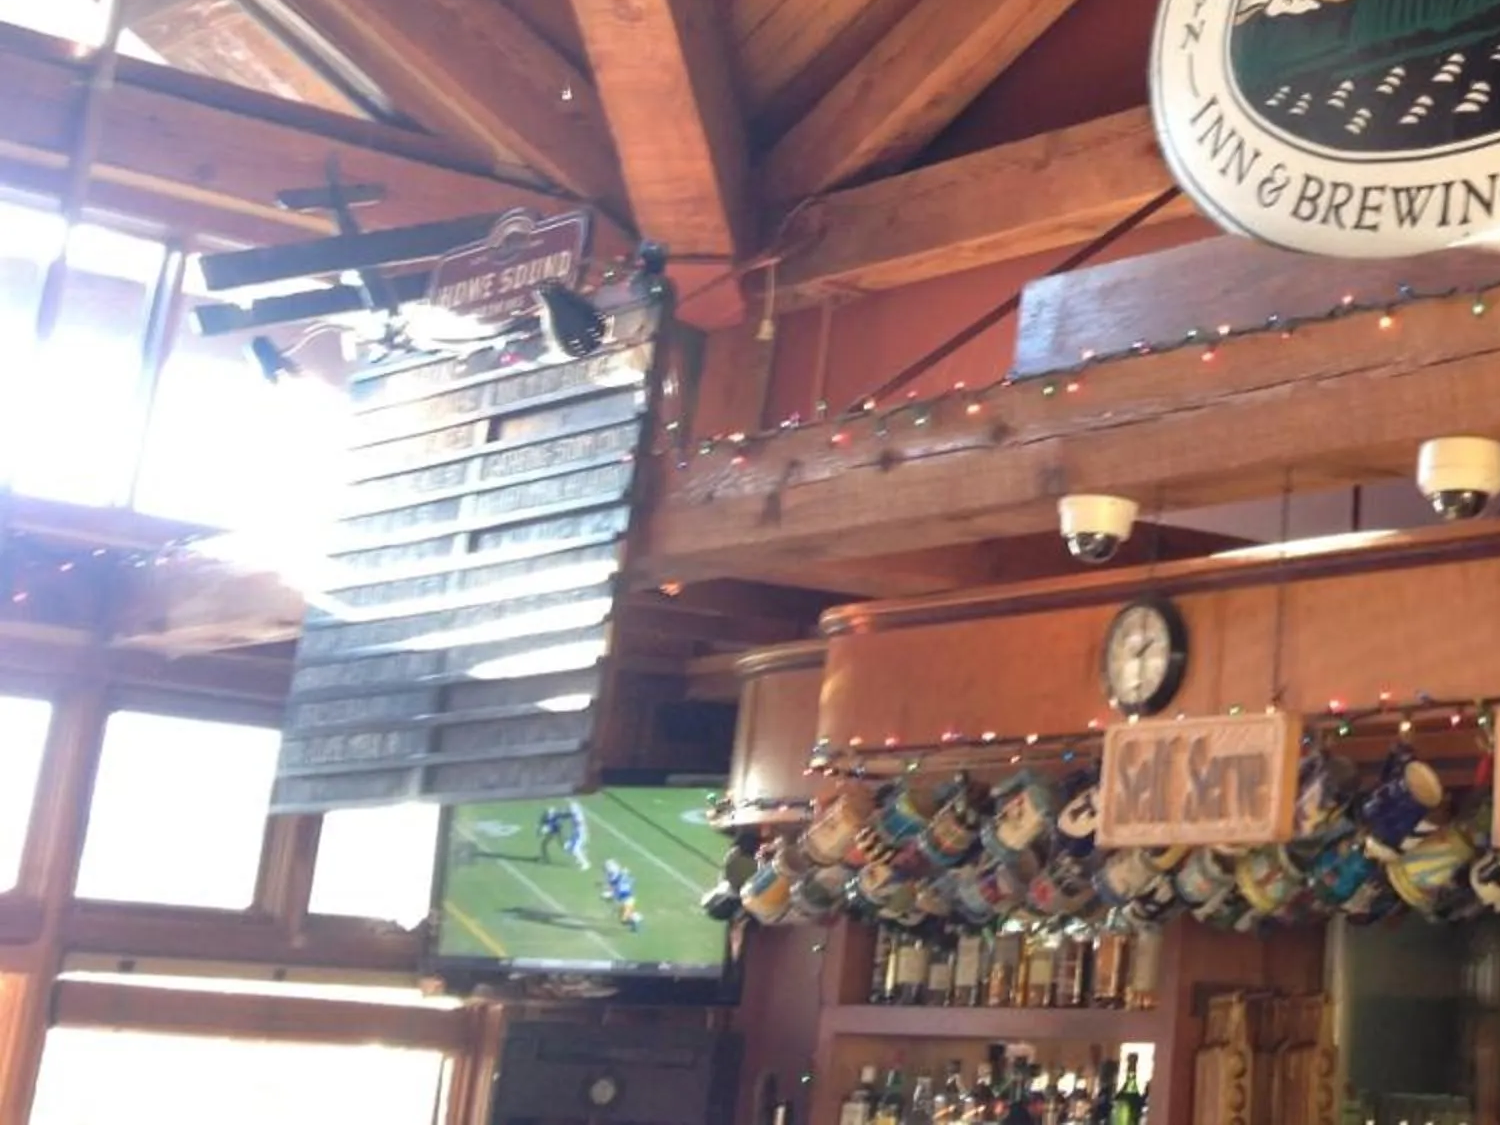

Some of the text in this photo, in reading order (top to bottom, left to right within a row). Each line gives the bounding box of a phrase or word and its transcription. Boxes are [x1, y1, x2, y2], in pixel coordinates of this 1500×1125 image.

[1189, 93, 1262, 187] INN
[1257, 162, 1292, 209] &
[499, 250, 572, 294] SOUND
[1115, 736, 1182, 826] Self
